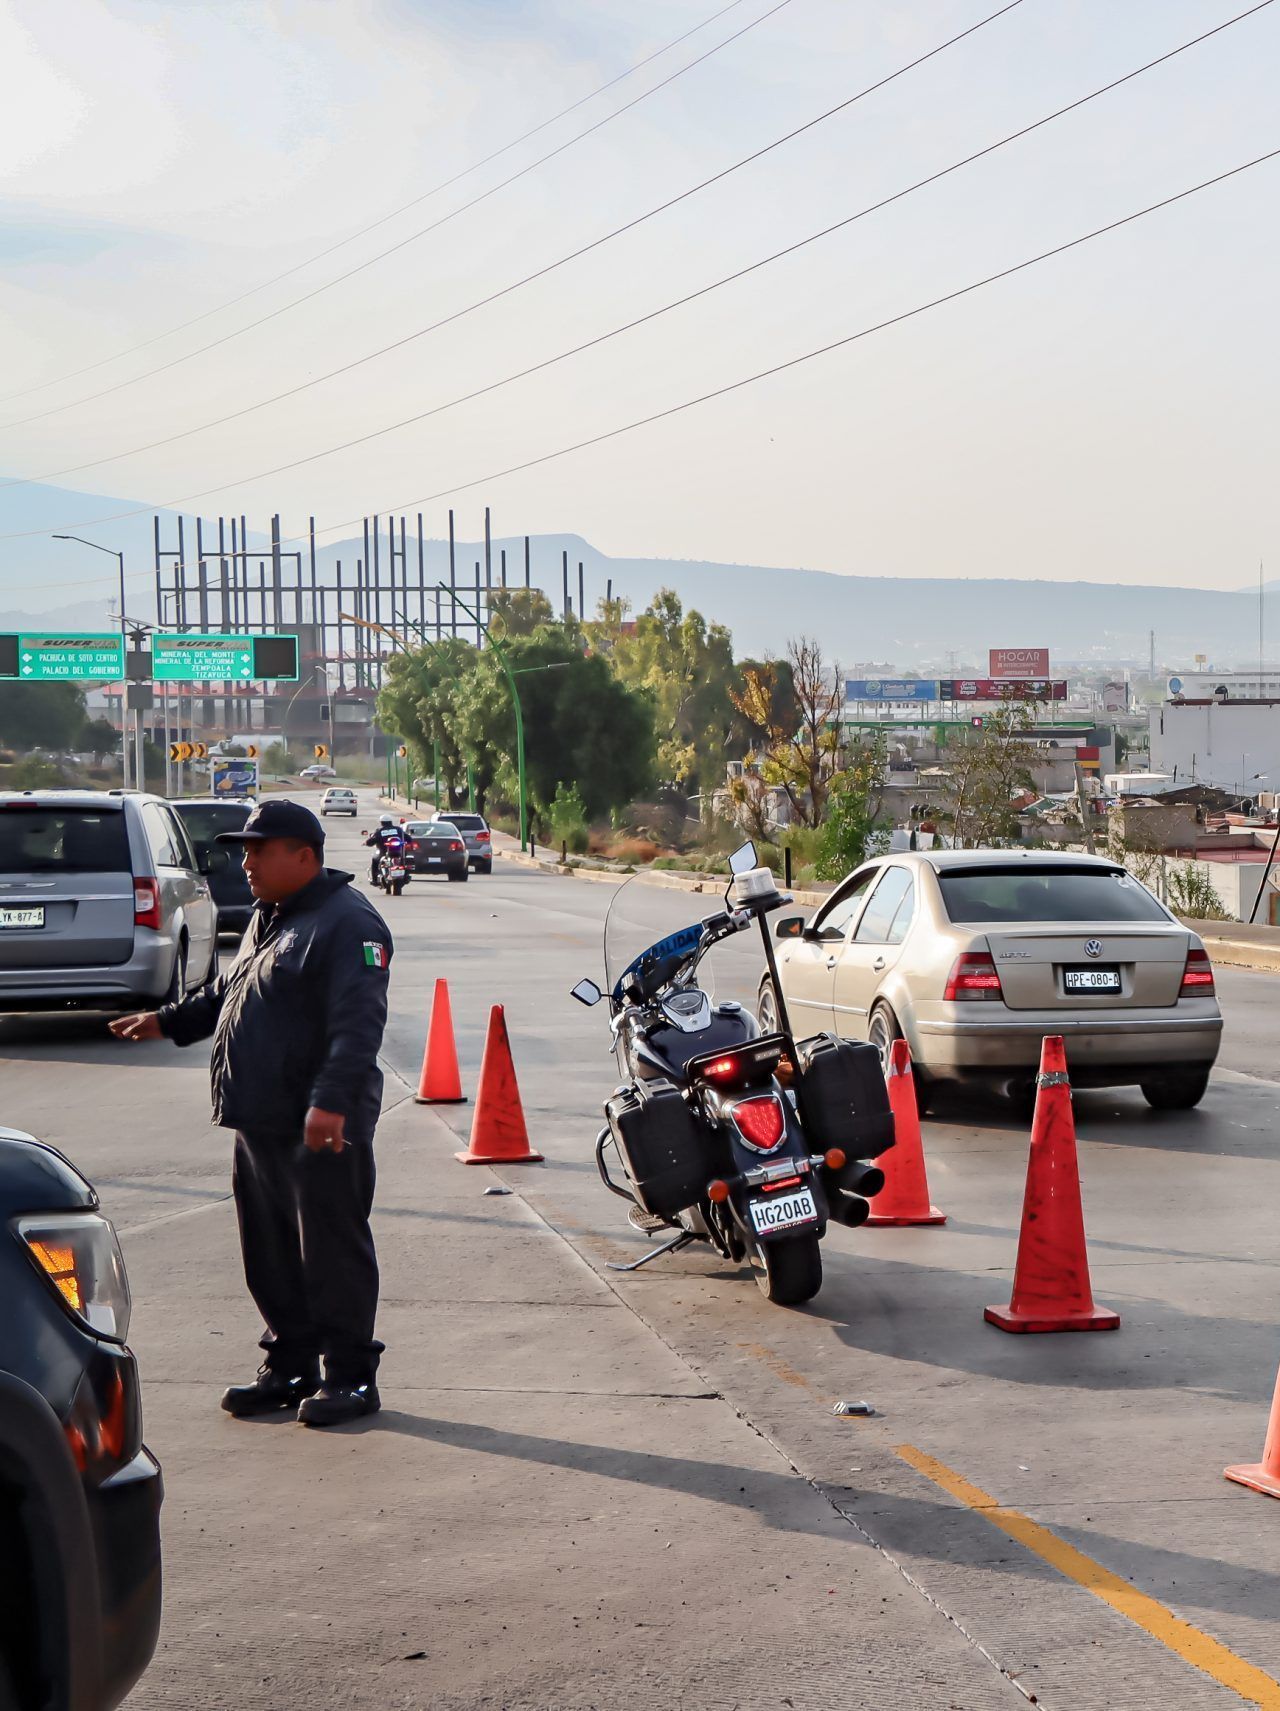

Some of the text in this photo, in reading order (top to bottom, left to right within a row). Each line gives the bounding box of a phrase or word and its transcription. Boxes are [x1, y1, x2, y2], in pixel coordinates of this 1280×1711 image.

[39, 653, 118, 662] PACHUCA DE SOTO CENTRO
[212, 651, 235, 659] MONTE
[998, 651, 1040, 662] HOGAR
[42, 666, 120, 675] PALACIO DEL GOBIERNO
[0, 912, 43, 922] YK-877-A
[1067, 974, 1119, 986] HPE-080-A
[755, 1198, 811, 1227] HG20AB
